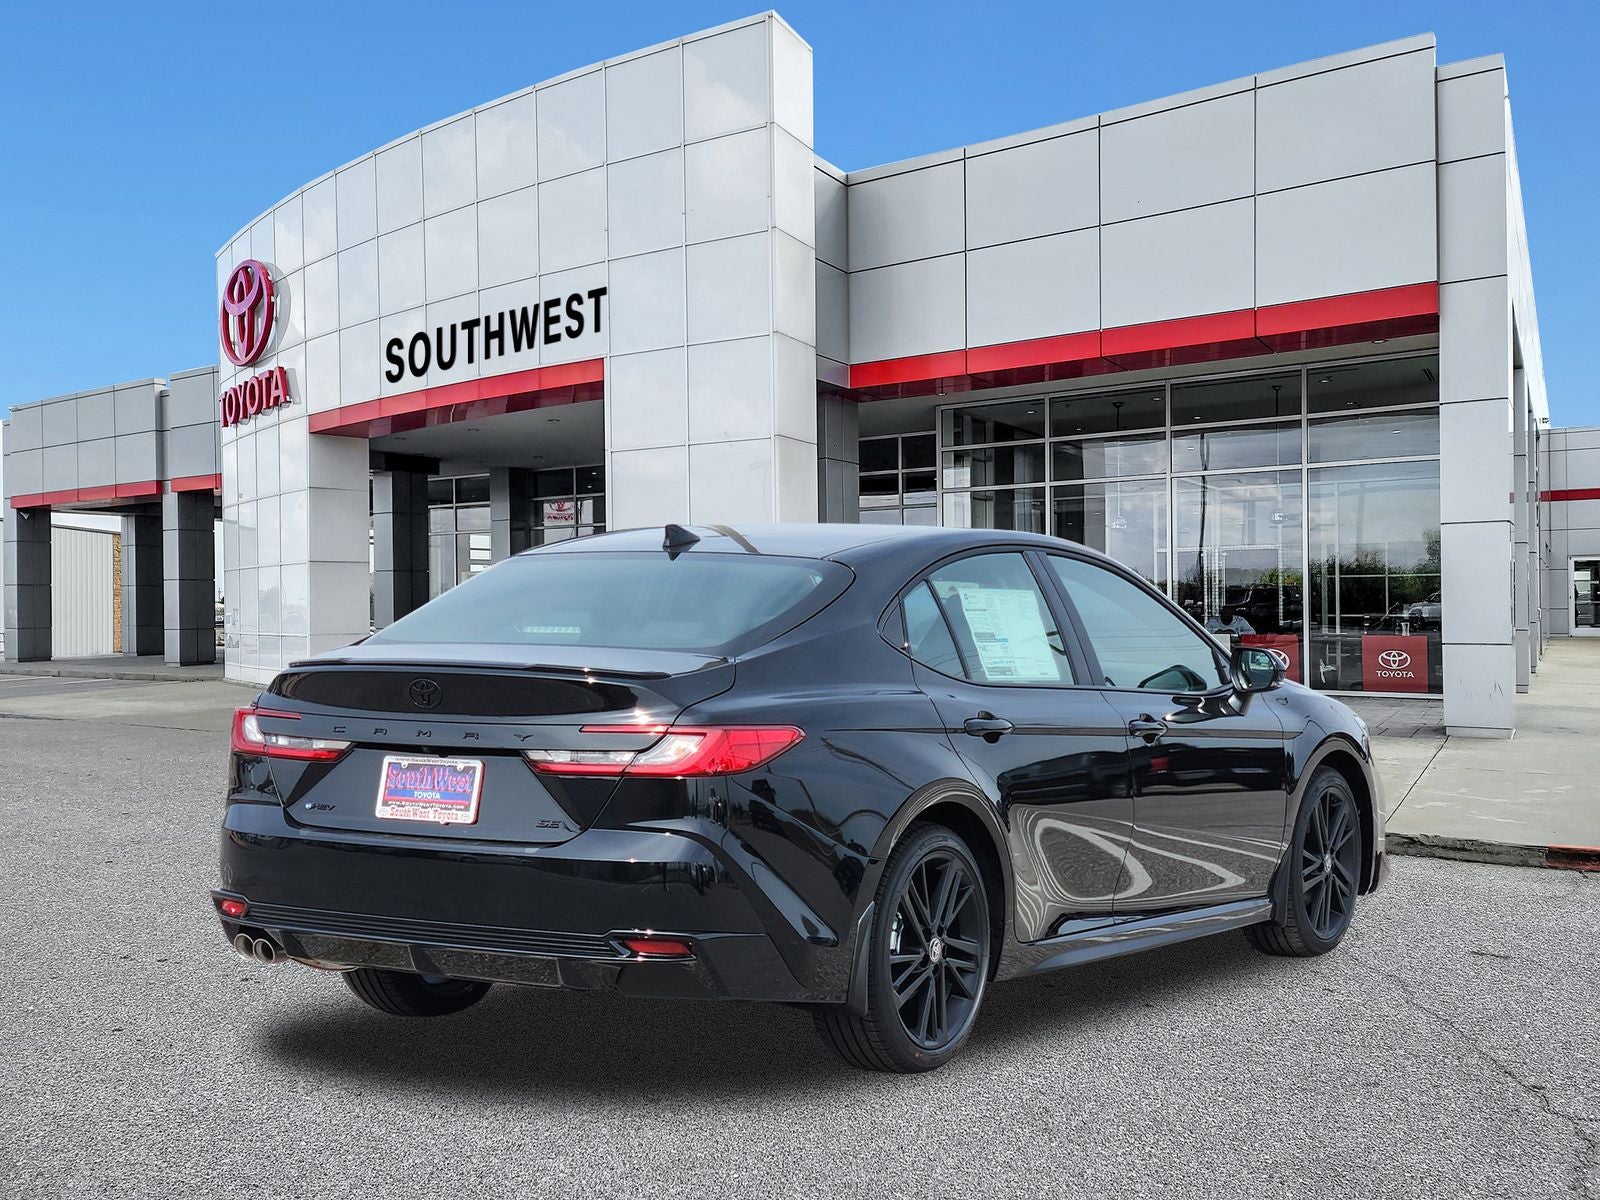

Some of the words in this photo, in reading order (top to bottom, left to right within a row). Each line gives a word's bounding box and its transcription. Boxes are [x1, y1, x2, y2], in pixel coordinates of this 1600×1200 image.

[385, 286, 607, 384] SOUTHWEST
[219, 366, 290, 428] TOYOTA
[1376, 670, 1415, 678] TOYOTA
[333, 726, 534, 742] CAMRY
[414, 791, 441, 799] TOYOTA
[433, 809, 459, 821] Toyota
[536, 820, 562, 829] SE
